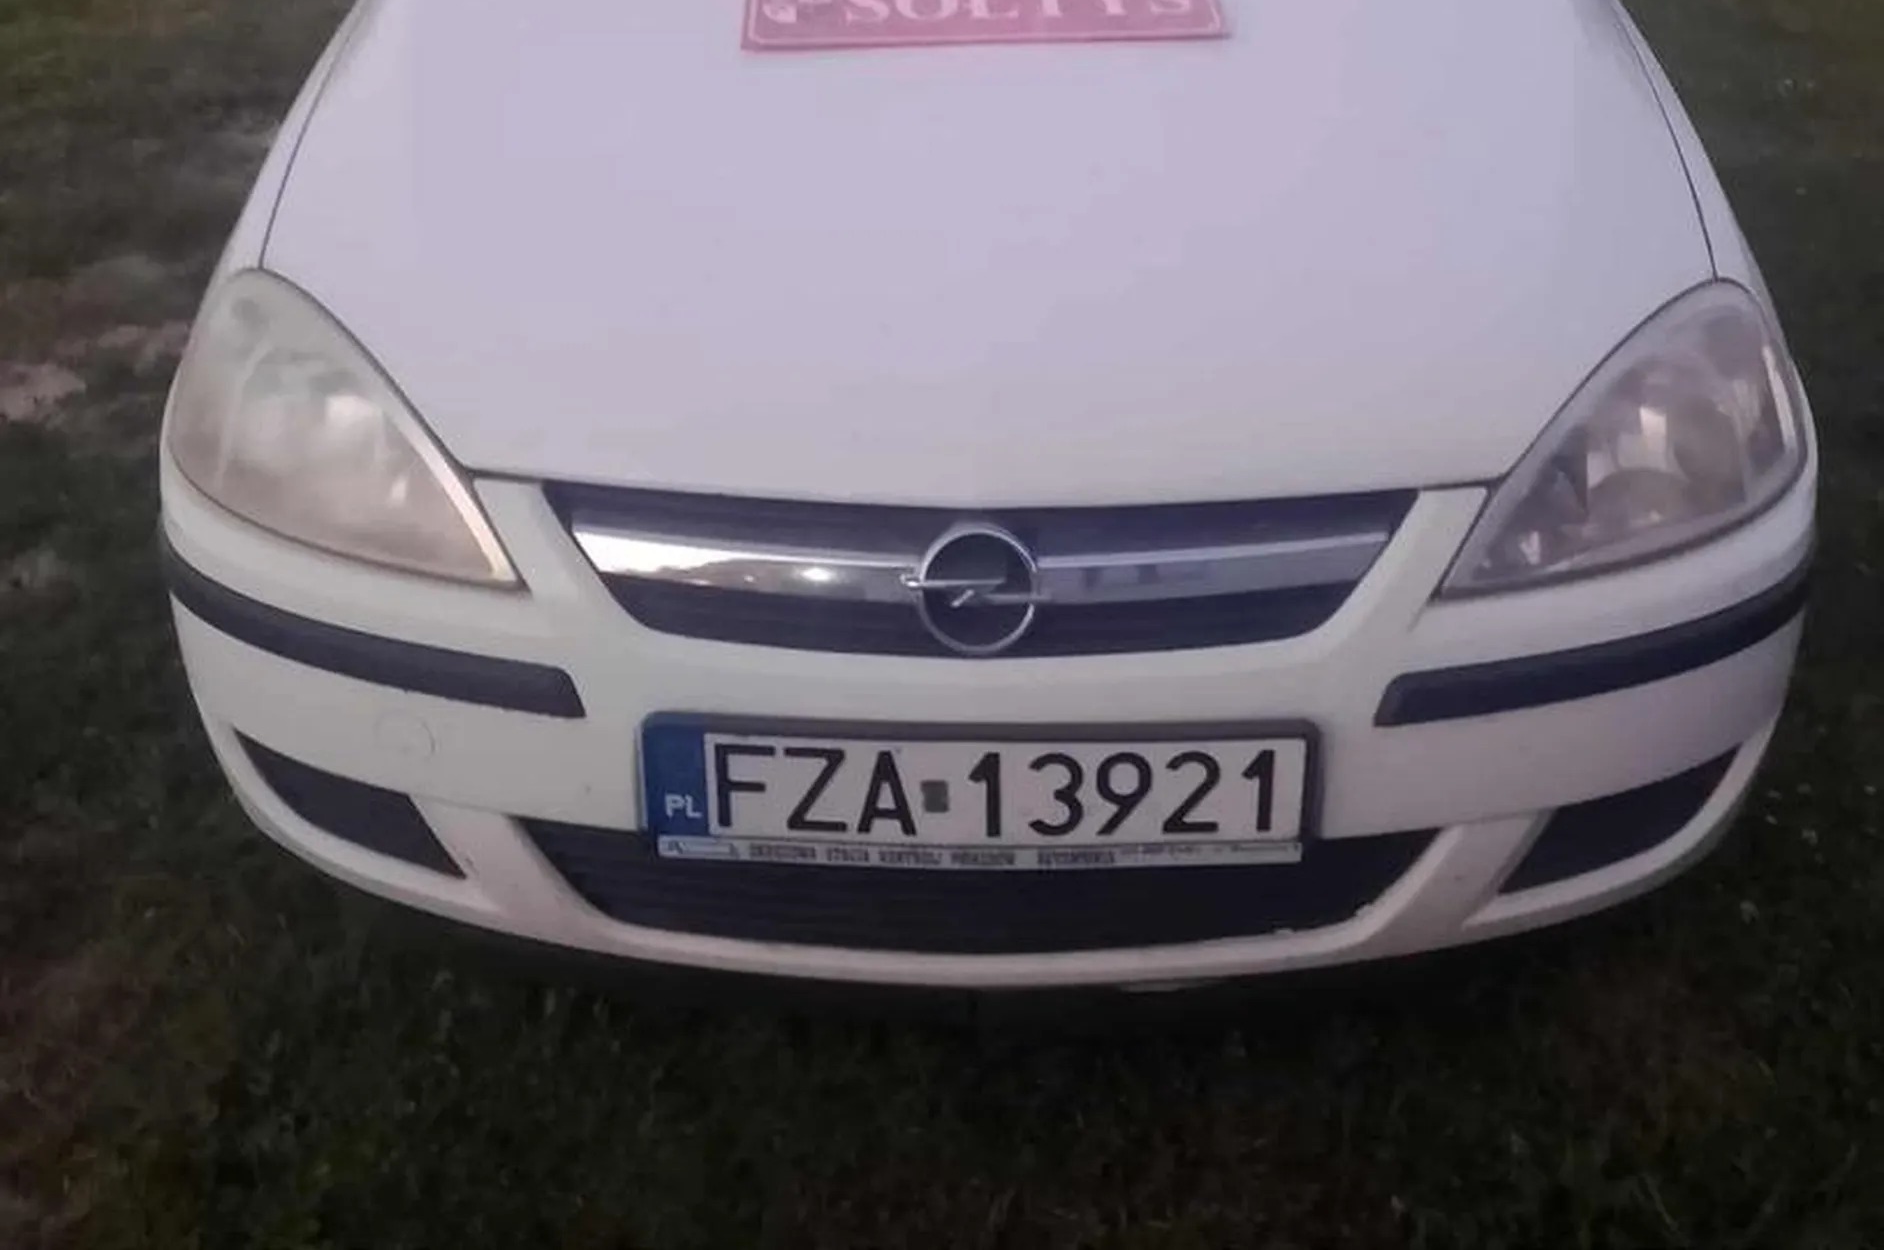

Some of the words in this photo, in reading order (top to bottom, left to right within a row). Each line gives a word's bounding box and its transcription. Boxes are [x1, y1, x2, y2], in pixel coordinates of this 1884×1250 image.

[664, 794, 702, 819] PL
[713, 743, 917, 837] FZA
[967, 749, 1276, 838] 13921
